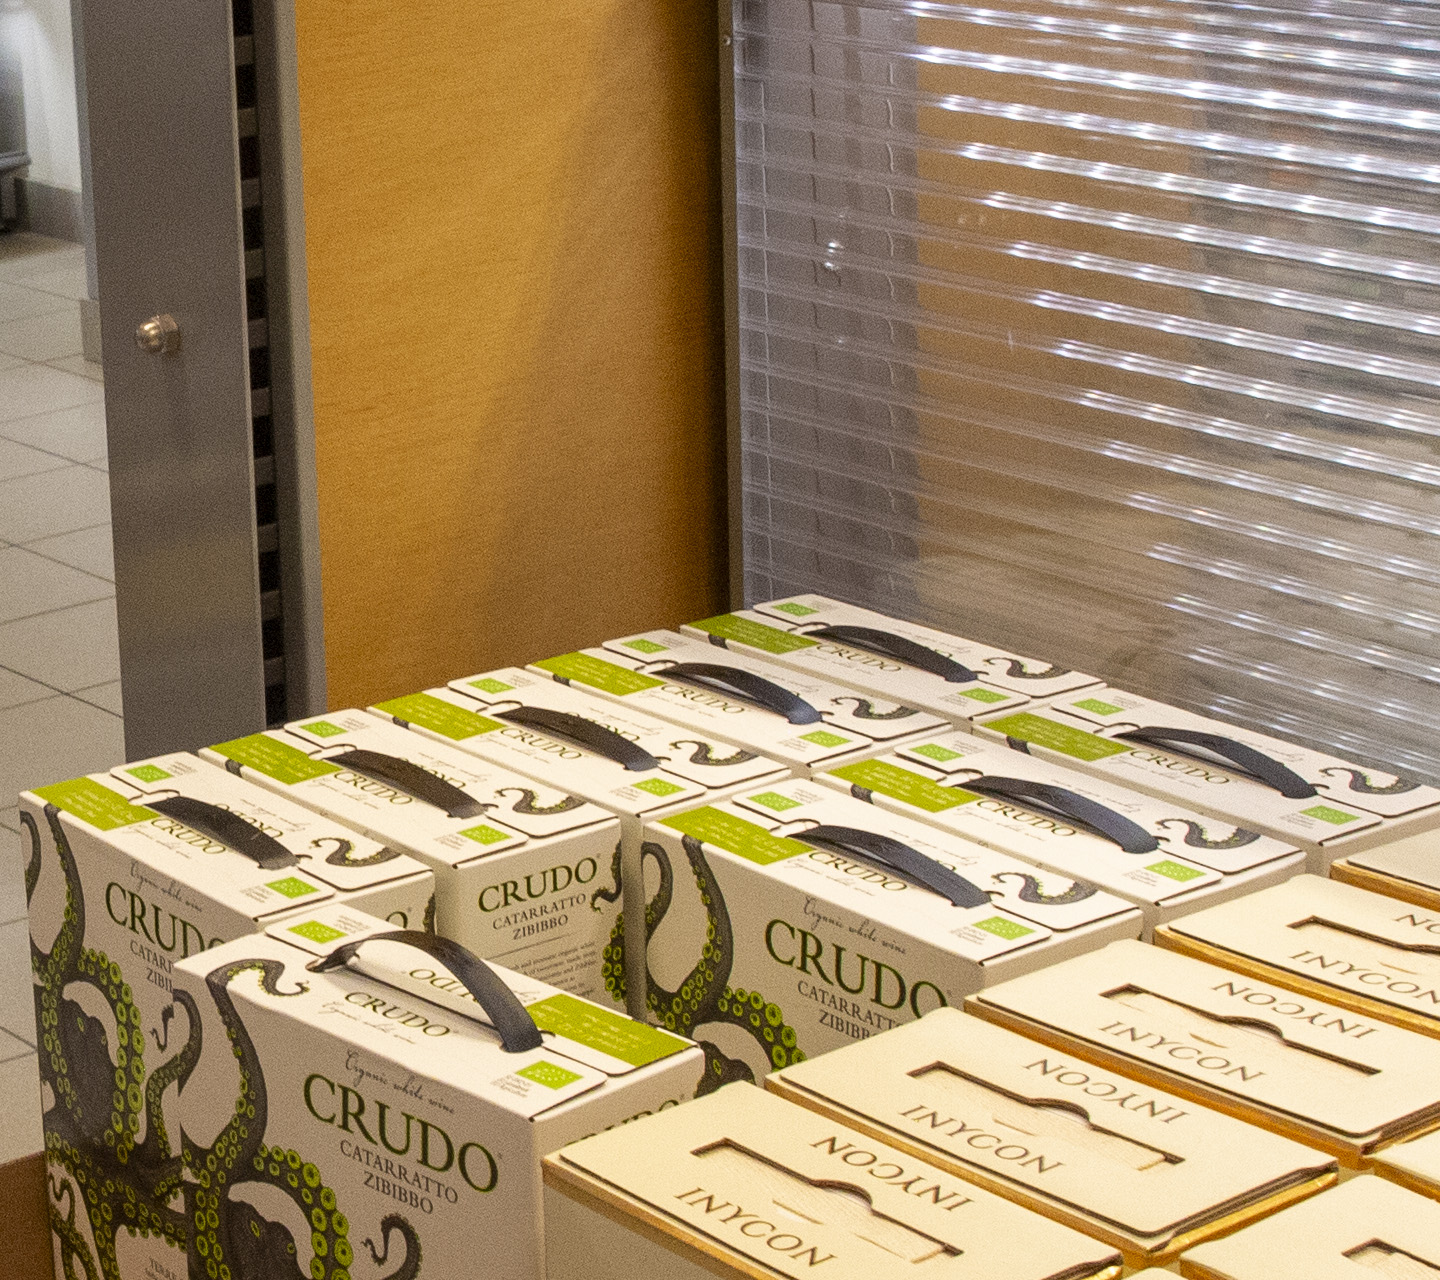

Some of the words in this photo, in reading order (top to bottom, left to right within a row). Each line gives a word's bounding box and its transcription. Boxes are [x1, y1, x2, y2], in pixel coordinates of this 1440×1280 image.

[818, 641, 902, 675] CRUDO
[660, 682, 745, 716] CRUDO
[499, 727, 584, 761] CRUDO
[1128, 749, 1230, 785] CRUDO
[333, 771, 413, 807] CRUDO
[150, 817, 226, 855] CRUDO
[975, 799, 1077, 839] CRUDO
[477, 857, 599, 917] CRUDO
[807, 848, 908, 893] CRUDO
[492, 893, 587, 931] CATARRATTO
[512, 913, 570, 941] ZIBIBBO
[765, 919, 950, 1019] CRUDO
[343, 989, 451, 1040] CRUDO
[1212, 979, 1382, 1041] INYCON
[1099, 1020, 1268, 1084] INYCON
[1021, 1058, 1191, 1126] INYCON
[303, 1072, 500, 1195] CRUDO
[898, 1104, 1067, 1174] INYCON
[339, 1138, 459, 1205] CATARRATTO
[363, 1170, 434, 1217] ZIBIBBO
[809, 1136, 976, 1213] INYCON
[673, 1186, 838, 1268] INYCON
